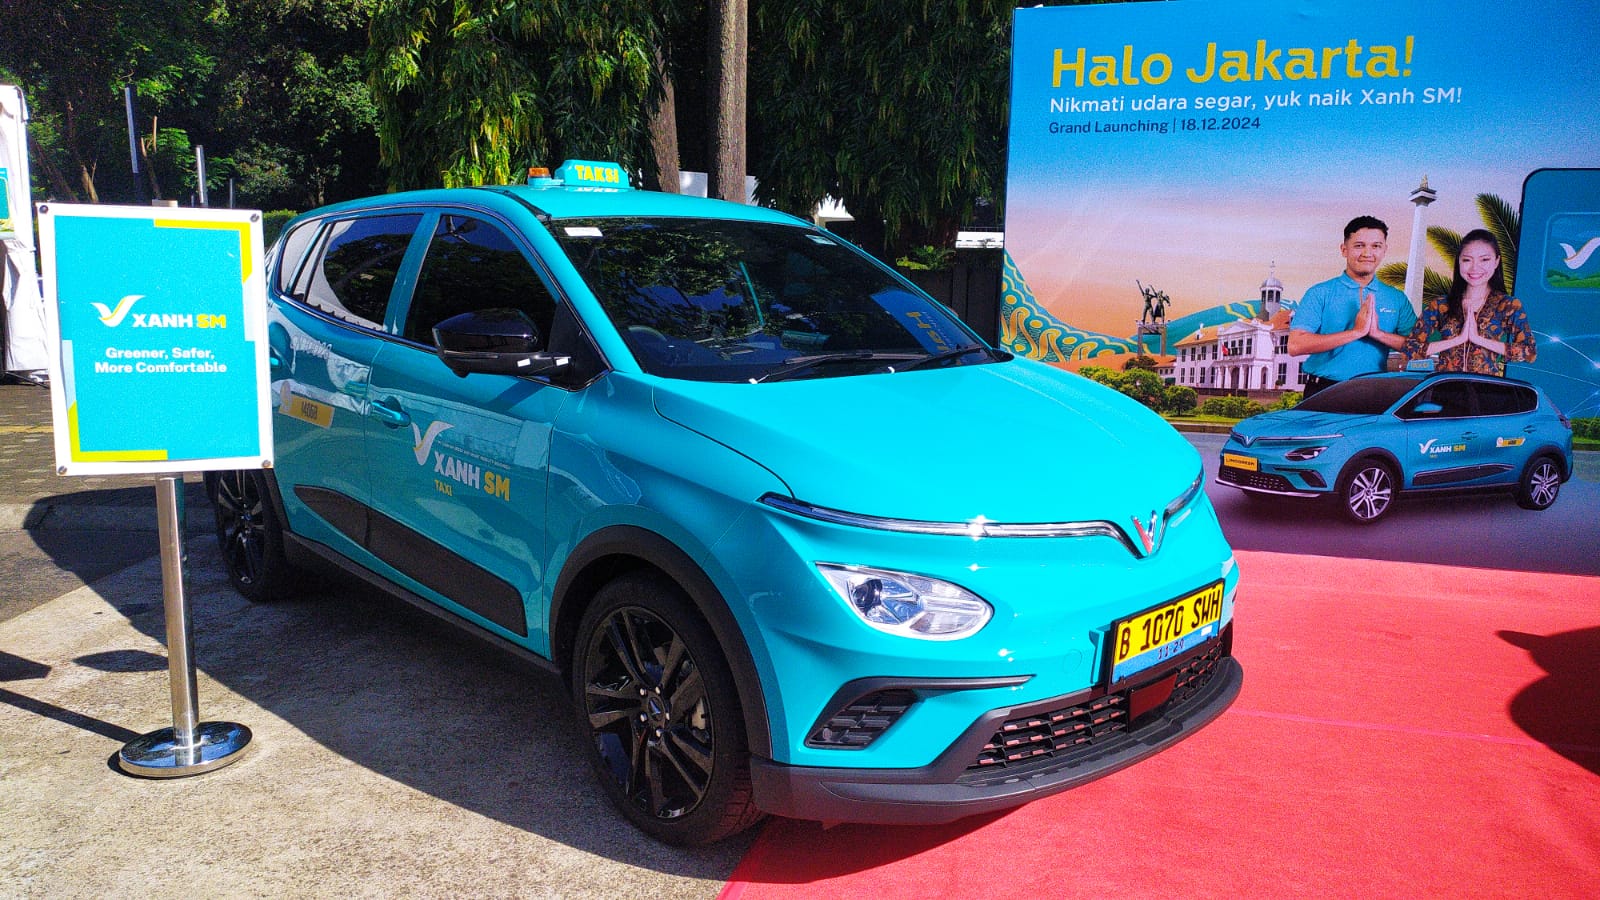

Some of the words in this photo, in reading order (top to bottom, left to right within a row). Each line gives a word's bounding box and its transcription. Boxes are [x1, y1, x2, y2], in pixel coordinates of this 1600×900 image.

[1052, 44, 1173, 87] Halo
[1185, 35, 1415, 83] Jakarta!
[1050, 95, 1125, 113] Nikmati
[1131, 95, 1187, 112] udara
[1194, 93, 1256, 112] segar,
[1264, 91, 1302, 110] yuk
[1308, 89, 1352, 107] naik
[1359, 87, 1415, 106] Xanh
[1422, 86, 1462, 104] SM!
[1049, 121, 1091, 134] Grand
[1095, 119, 1169, 133] Launching
[1181, 117, 1261, 131] 18.12.2024
[574, 164, 620, 184] TAKSI
[132, 313, 194, 329] XANH
[196, 313, 227, 329] SM
[105, 346, 169, 360] Greener,
[171, 346, 215, 360] Safer,
[94, 361, 133, 374] More
[135, 360, 227, 374] Comfortable
[1430, 445, 1452, 454] XANH
[434, 450, 481, 491] XANH
[483, 470, 511, 502] SM
[434, 478, 453, 497] TAXI
[1119, 626, 1132, 661] B
[1140, 605, 1185, 652] 1070
[1191, 589, 1221, 629] SWH
